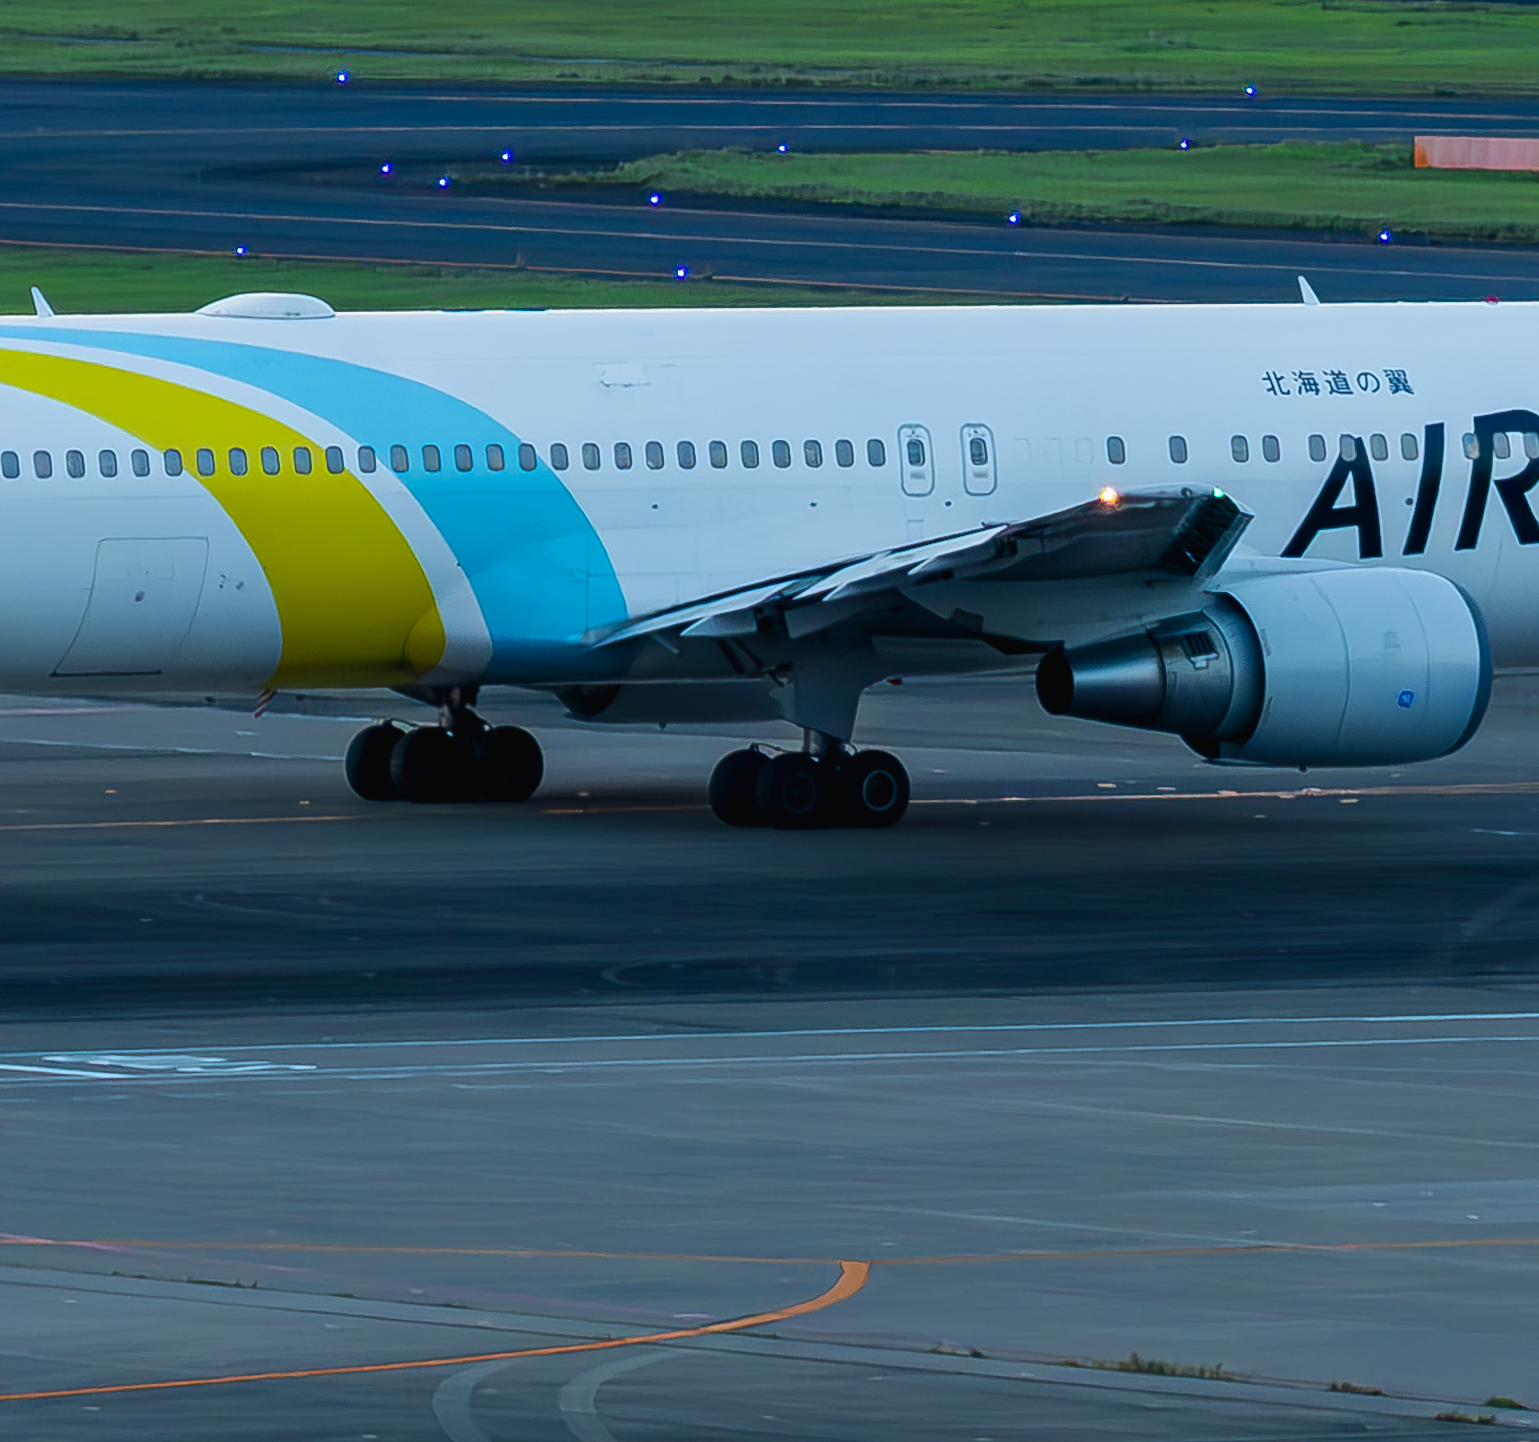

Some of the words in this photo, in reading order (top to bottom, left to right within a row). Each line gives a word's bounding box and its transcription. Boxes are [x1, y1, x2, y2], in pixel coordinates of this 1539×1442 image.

[1261, 369, 1415, 397] 北海道の翼
